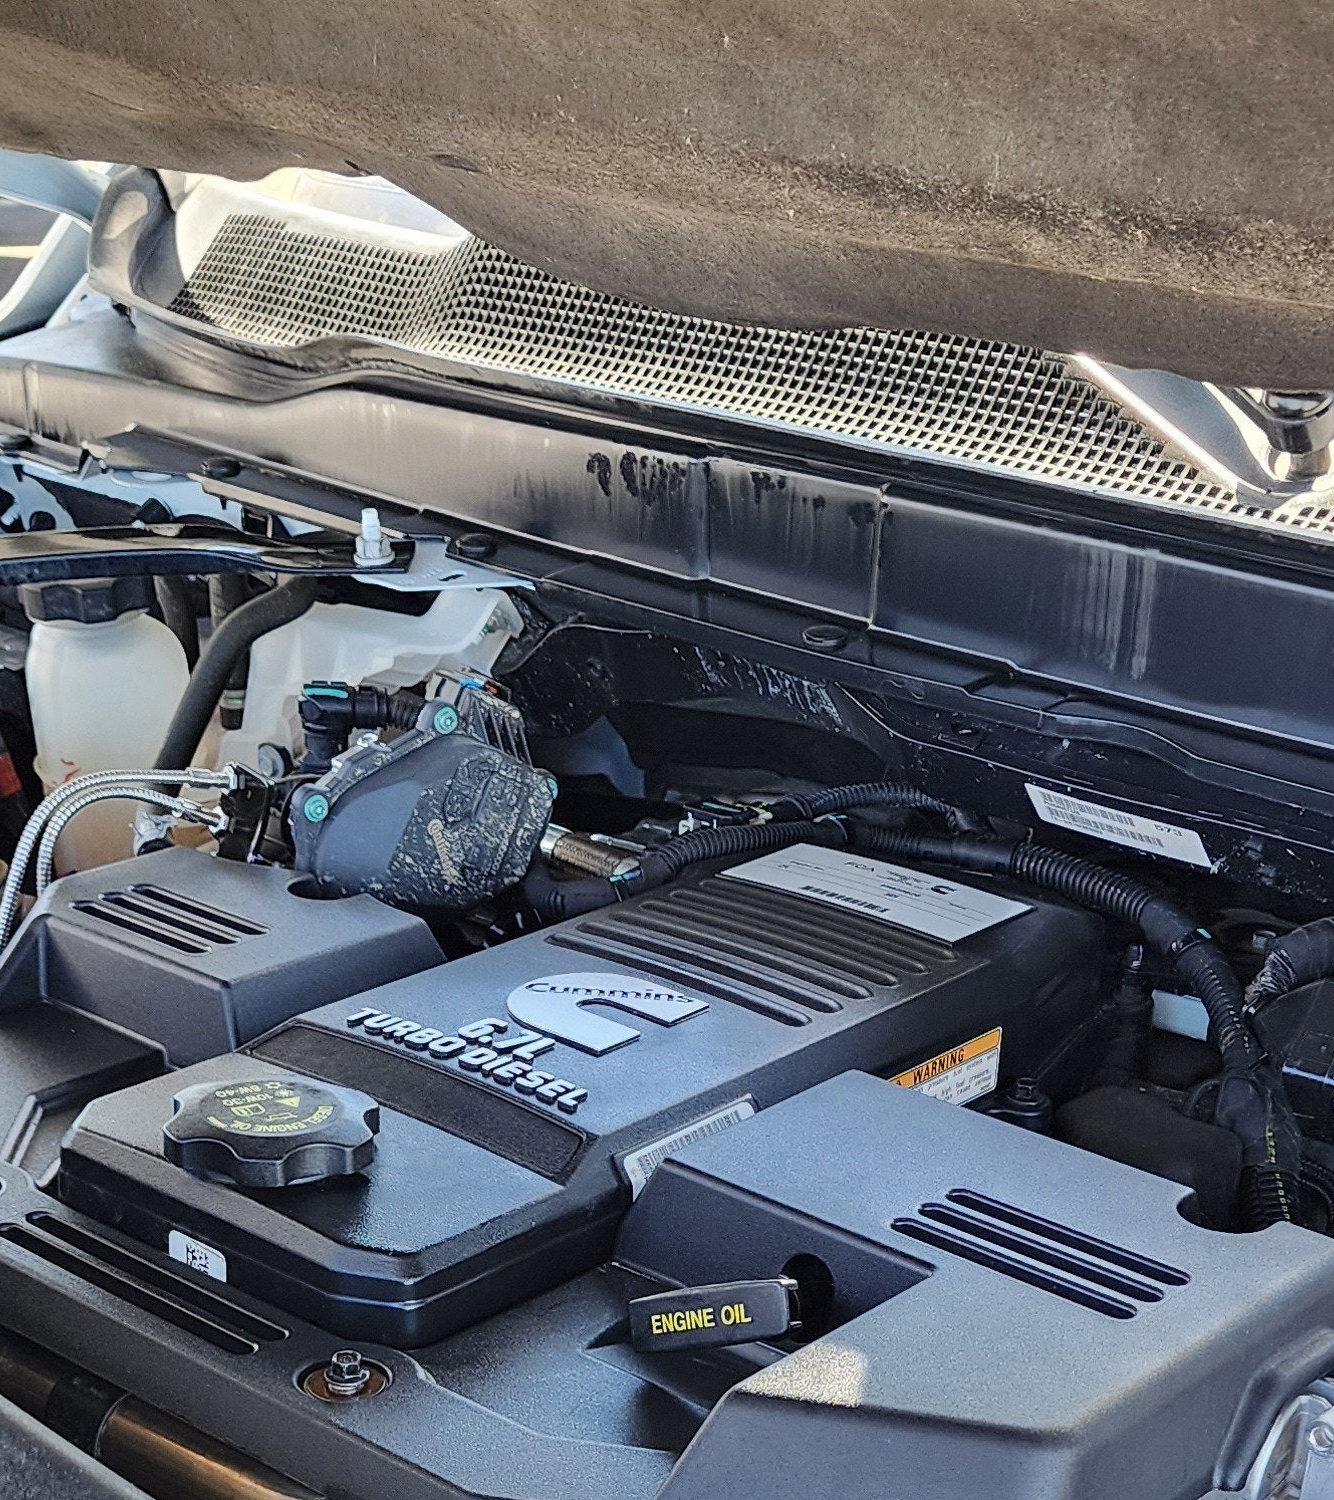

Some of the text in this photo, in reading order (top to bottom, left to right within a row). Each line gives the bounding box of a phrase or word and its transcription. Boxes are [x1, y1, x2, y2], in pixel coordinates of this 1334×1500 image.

[524, 981, 696, 1003] Cummins
[458, 1017, 555, 1065] 6.7L
[346, 1007, 588, 1114] TURBO DIESEL
[912, 1048, 965, 1085] WARNING
[253, 1121, 308, 1133] ENGINE
[651, 1303, 752, 1335] ENGINE OIL
